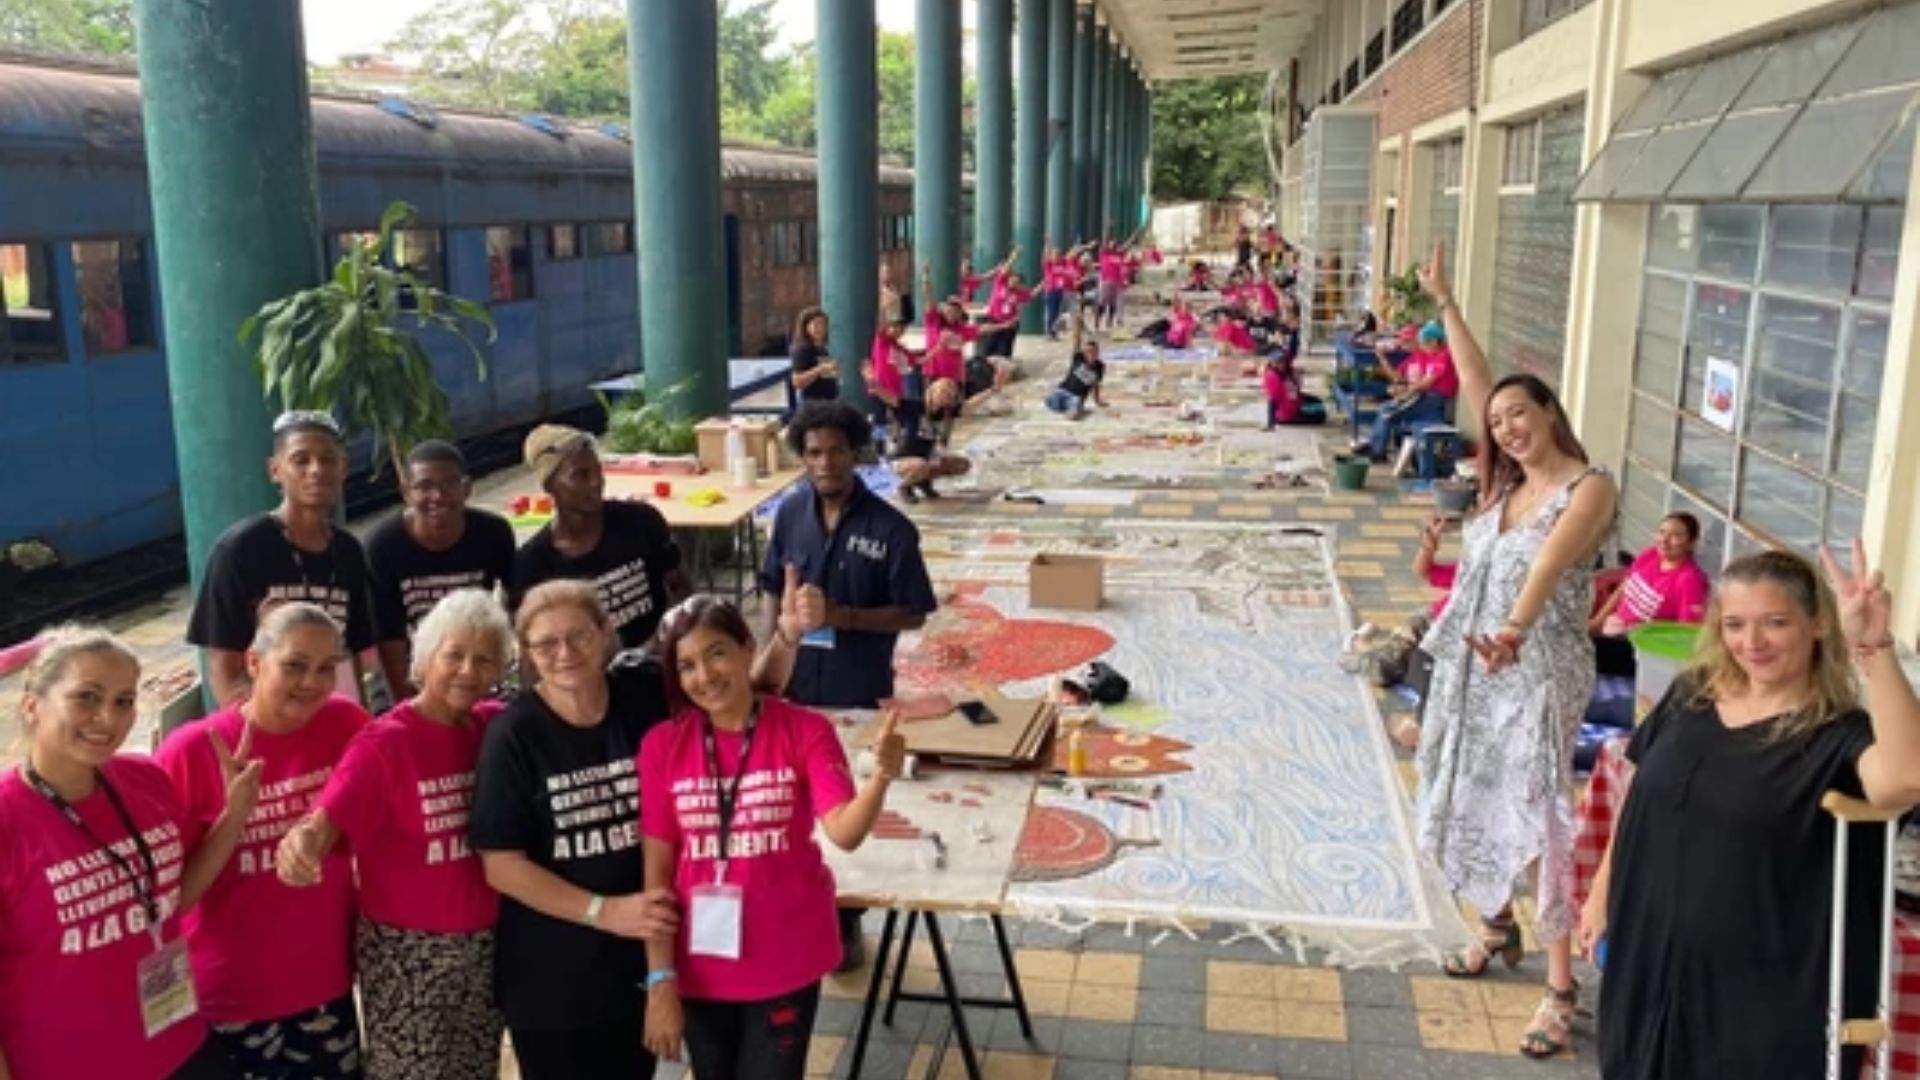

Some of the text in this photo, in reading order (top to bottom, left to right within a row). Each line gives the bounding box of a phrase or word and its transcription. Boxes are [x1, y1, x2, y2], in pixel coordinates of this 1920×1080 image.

[425, 838, 445, 866] A
[554, 835, 571, 860] A
[575, 828, 606, 859] LA
[45, 858, 79, 885] NO
[240, 847, 276, 876] A L
[53, 867, 117, 906] GENTE
[60, 926, 83, 955] A
[86, 912, 123, 949] LA
